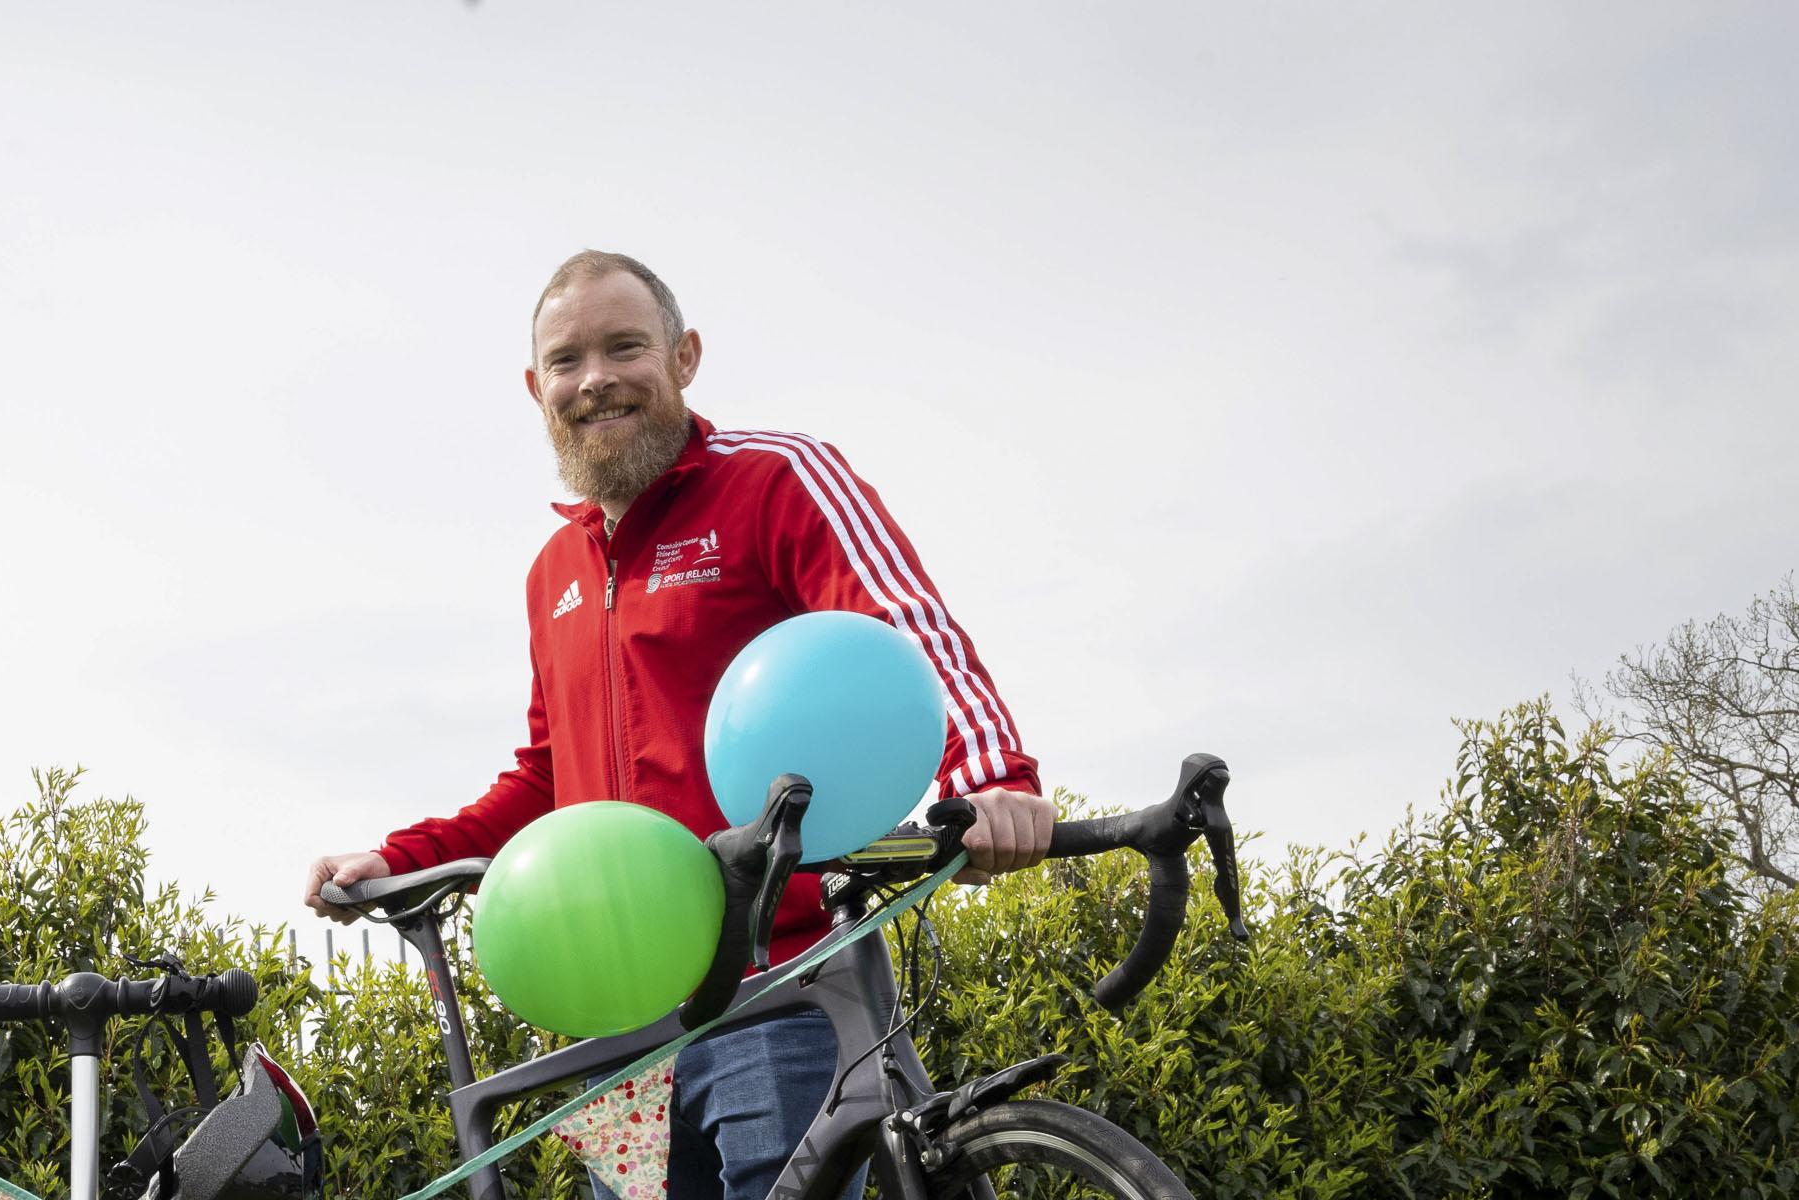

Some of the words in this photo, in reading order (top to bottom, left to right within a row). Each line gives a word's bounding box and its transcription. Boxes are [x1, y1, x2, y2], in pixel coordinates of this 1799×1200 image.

[663, 572, 685, 583] SPORT
[686, 567, 720, 579] IRELAND
[553, 595, 583, 619] adidas
